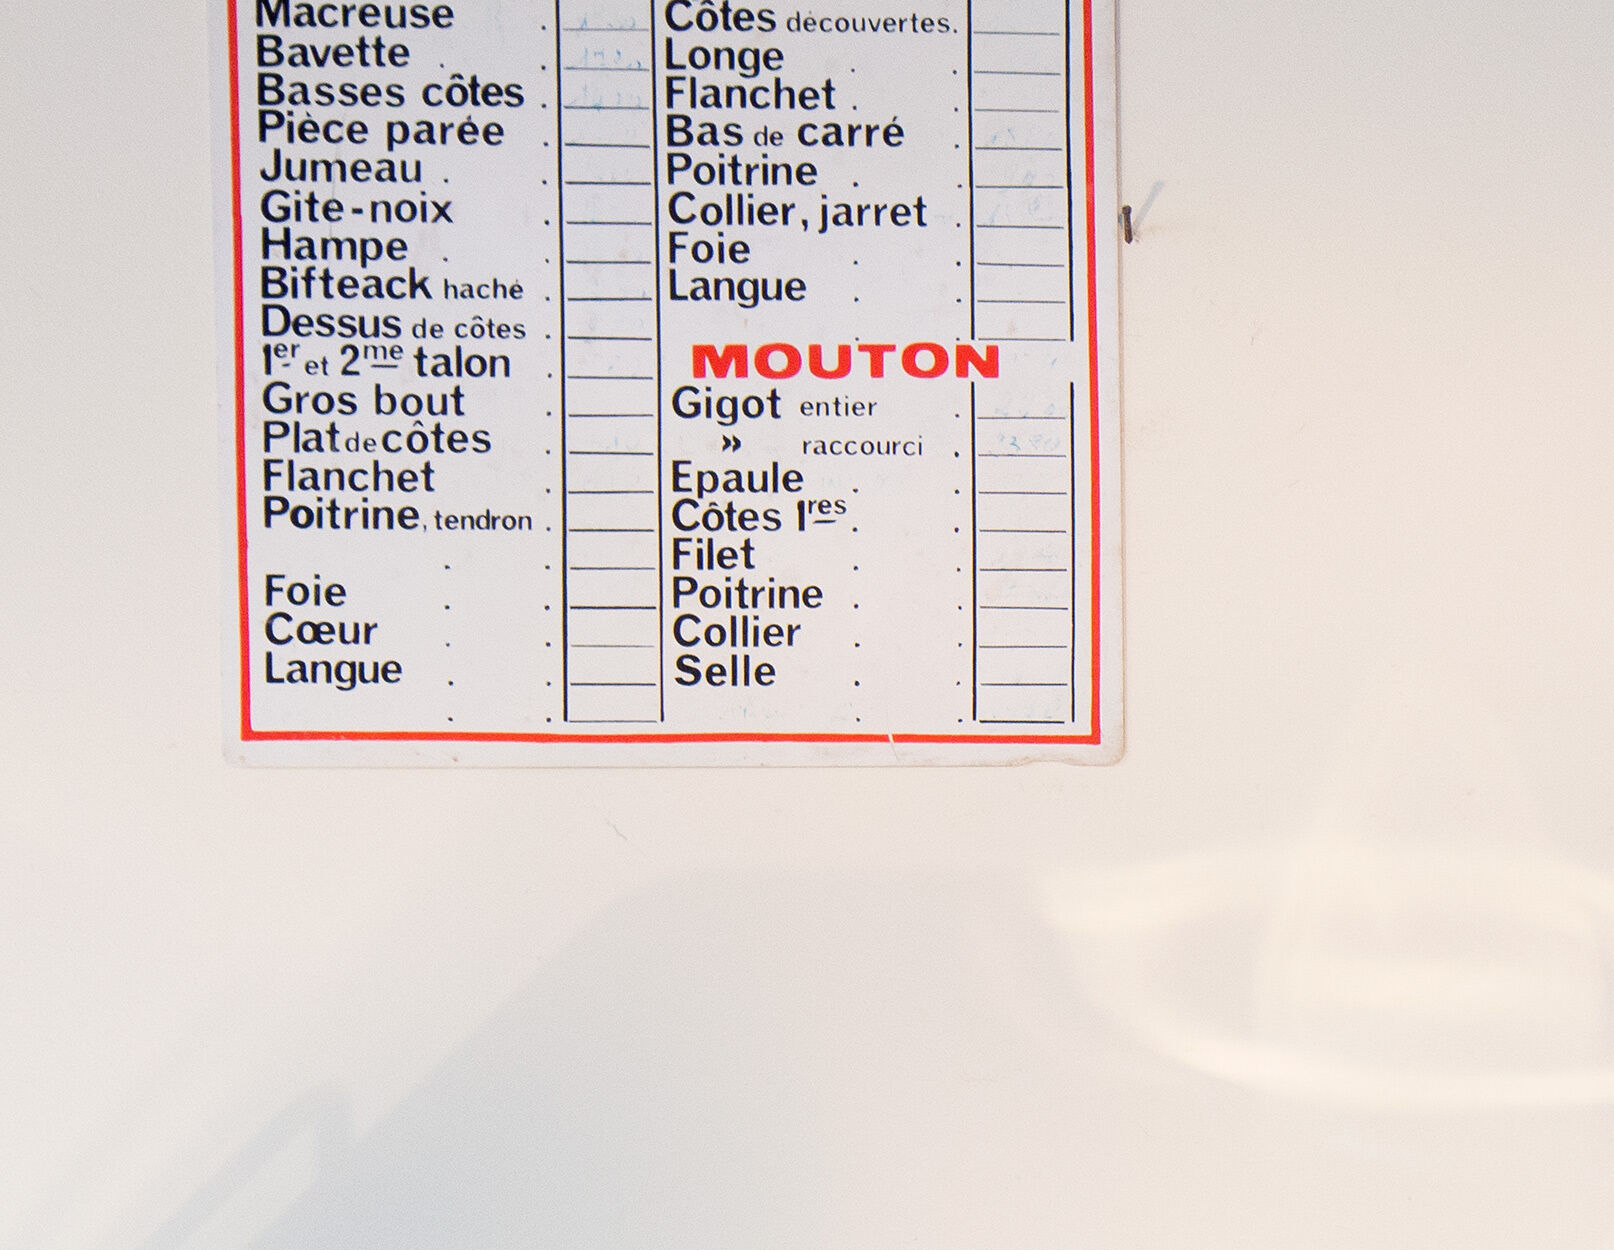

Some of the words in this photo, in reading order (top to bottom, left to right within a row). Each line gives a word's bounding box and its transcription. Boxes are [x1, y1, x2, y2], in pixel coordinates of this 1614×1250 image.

[255, 0, 455, 30] Macreuse
[664, 0, 777, 33] Côtes
[256, 33, 411, 69] Bavette
[665, 36, 785, 79] Longe
[257, 71, 406, 108] Basses
[421, 72, 525, 108] côtes
[665, 75, 836, 111] Flanchet
[257, 108, 369, 145] Pièce
[386, 114, 505, 152] parée
[666, 113, 744, 148] Bas
[753, 124, 784, 147] de
[797, 115, 905, 148] carré
[259, 147, 422, 184] Jumeau
[666, 152, 818, 187] Poitrine
[668, 190, 809, 234] Collier,
[817, 193, 928, 235] jarret
[260, 226, 408, 270] Hampe
[668, 230, 751, 265] Foie
[260, 264, 433, 300] Bifteack
[443, 277, 524, 300] haché
[669, 268, 807, 309] Langue
[261, 303, 402, 339] Dessus
[411, 317, 444, 340] de
[454, 315, 527, 340] côtes
[304, 355, 329, 377] et
[413, 344, 511, 378] talon
[692, 342, 1000, 380] MOUTON
[262, 380, 358, 416] Gros
[374, 382, 465, 417] bout
[671, 385, 782, 427] Gigot
[799, 395, 878, 417] entier
[263, 420, 341, 454] Plat
[344, 431, 377, 453] de
[381, 419, 492, 455] côtes
[802, 435, 922, 456] raccourci
[263, 458, 435, 493] Flanchet
[672, 459, 804, 500] Epaule
[263, 494, 427, 531] Poitrine,
[433, 508, 532, 531] tendron
[671, 497, 782, 533] Côtes
[672, 537, 756, 571] Filet
[265, 573, 347, 607] Foie
[672, 575, 824, 610] Poitrine
[264, 611, 378, 646] Cœur
[673, 613, 801, 648] Collier
[265, 651, 403, 692] Langue
[674, 653, 776, 687] Selle
